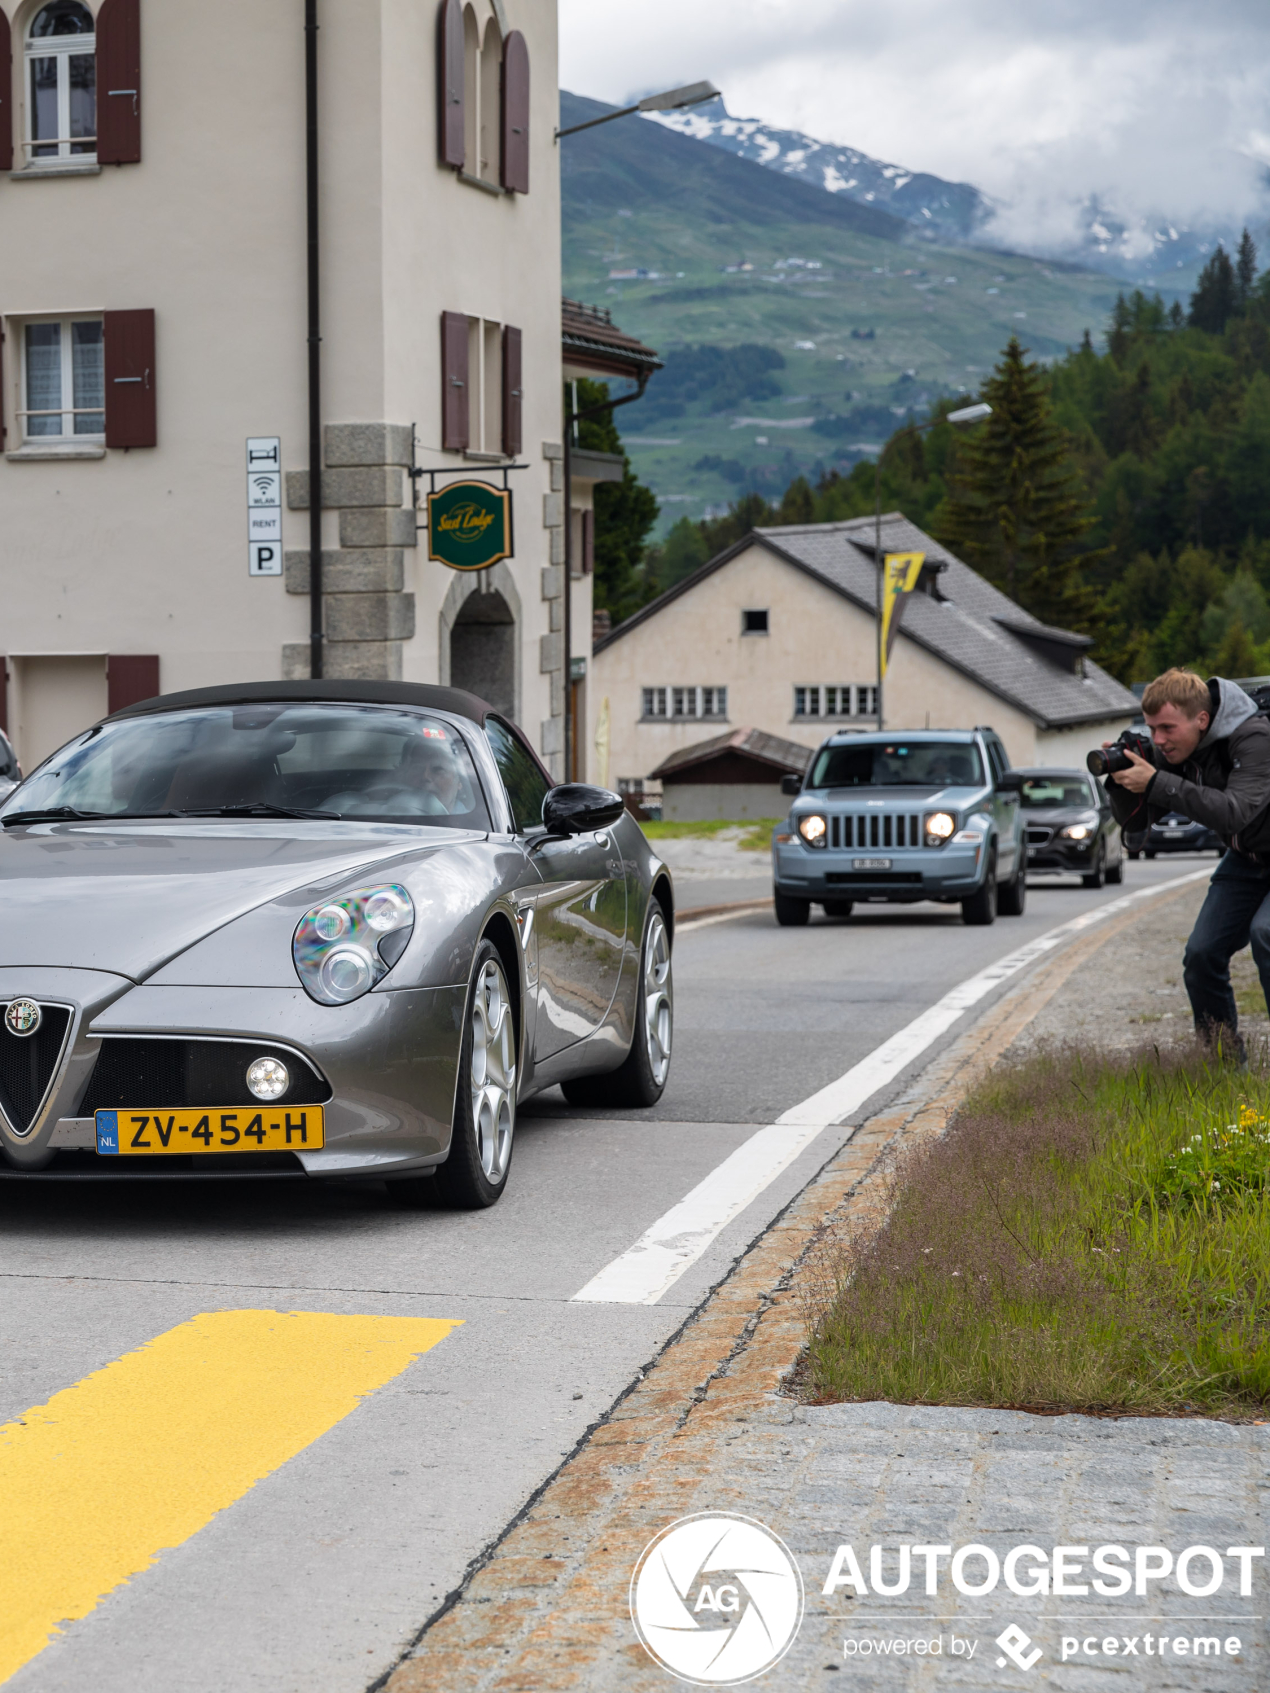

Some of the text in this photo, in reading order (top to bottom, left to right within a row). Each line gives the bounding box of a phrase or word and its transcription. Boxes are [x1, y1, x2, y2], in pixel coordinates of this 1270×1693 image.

[252, 520, 277, 528] RENT
[462, 507, 495, 531] Lodge
[257, 547, 274, 570] P
[101, 1137, 116, 1147] NL
[130, 1113, 308, 1148] ZV-454-H
